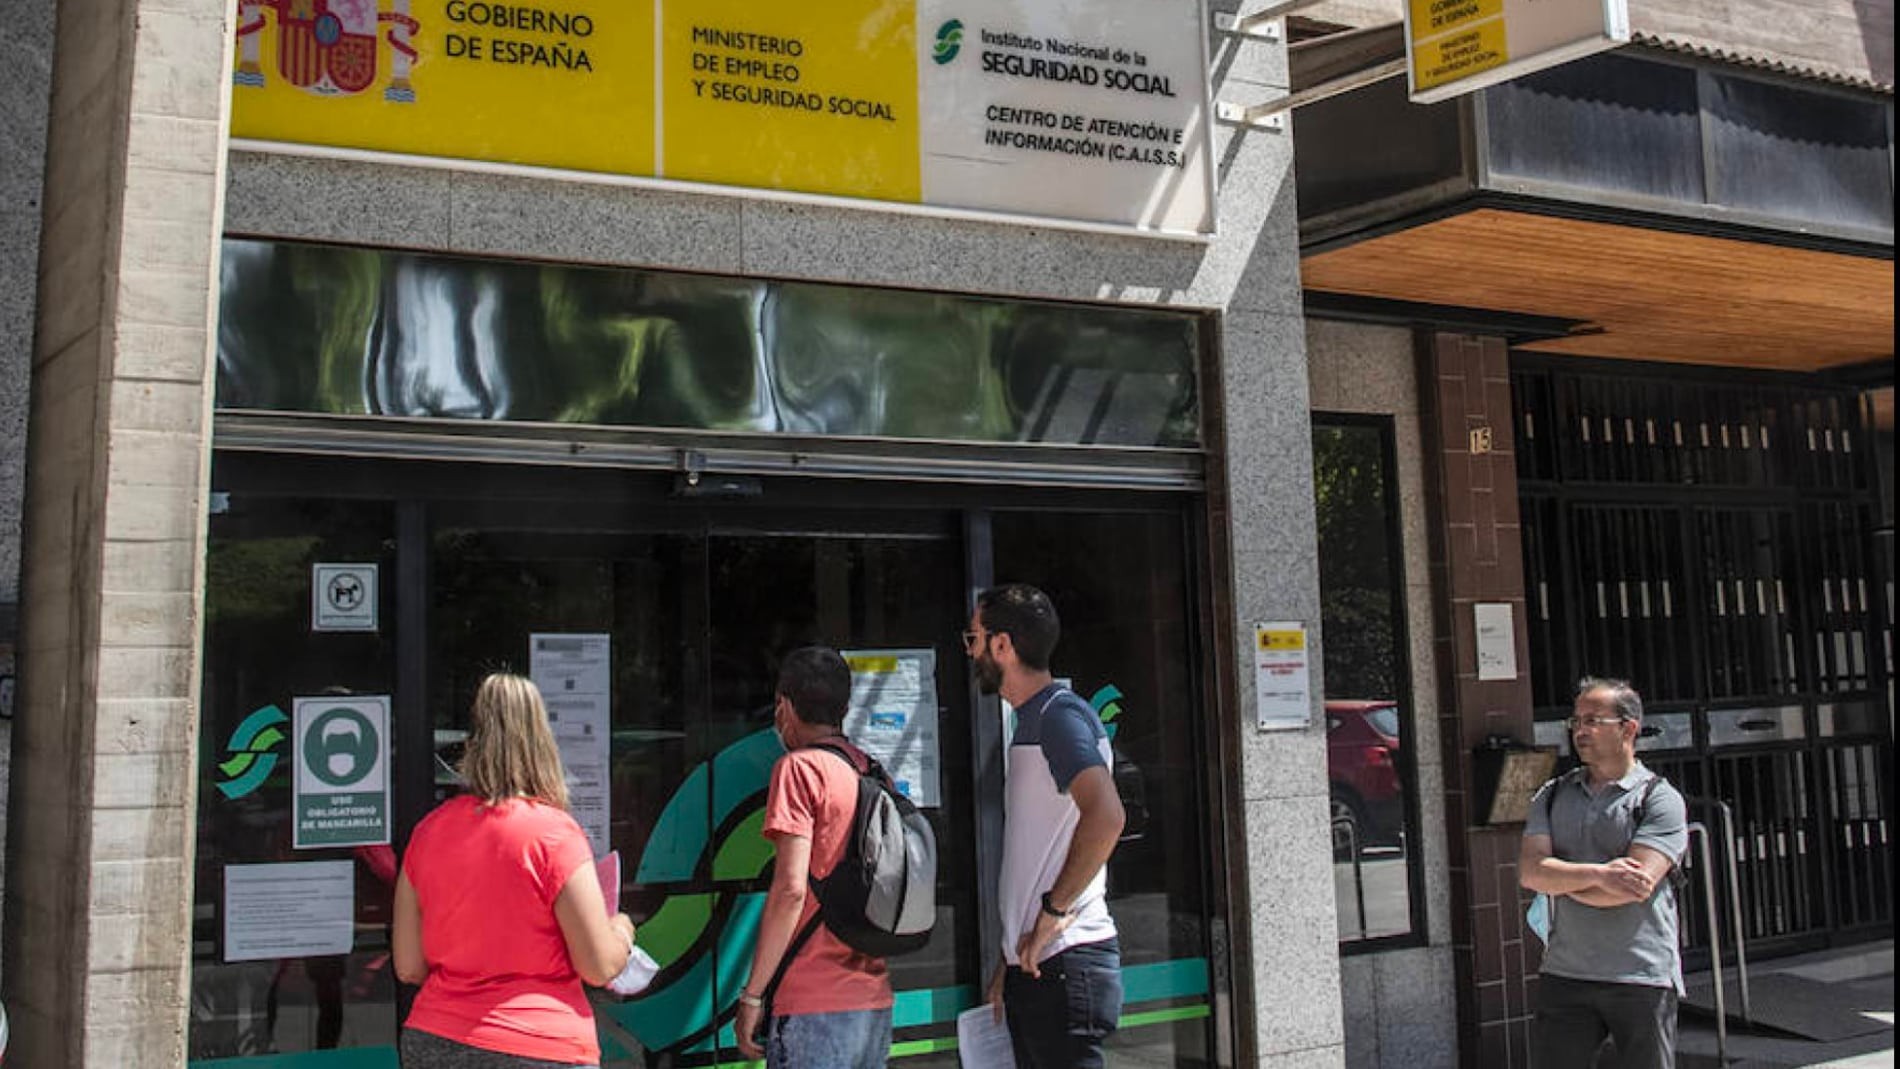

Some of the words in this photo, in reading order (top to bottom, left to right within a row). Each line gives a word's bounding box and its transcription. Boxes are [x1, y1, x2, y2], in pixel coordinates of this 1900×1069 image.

[446, 0, 593, 37] GOBIERNO
[446, 34, 482, 59] DE
[492, 39, 593, 72] ESPAÑA
[692, 26, 803, 56] MINISTERIO
[981, 29, 1042, 50] Instituto
[1046, 38, 1109, 61] Nacional
[1113, 48, 1131, 65] de
[1134, 51, 1147, 67] la
[693, 53, 719, 73] DE
[726, 56, 799, 82] EMPLEO
[982, 51, 1098, 86] SEGURIDAD
[1104, 68, 1176, 97] SOCIAL
[694, 79, 705, 97] Y
[712, 82, 823, 111] SEGURIDAD
[829, 96, 896, 121] SOCIAL
[986, 104, 1056, 128] CENTRO
[1061, 114, 1084, 132] DE
[1088, 118, 1169, 144] ATENCIÓN
[1173, 129, 1183, 145] E
[985, 128, 1104, 158] INFORMACIÓN
[1108, 142, 1185, 169] (C.A.I.S.S.)
[1472, 428, 1491, 452] 15
